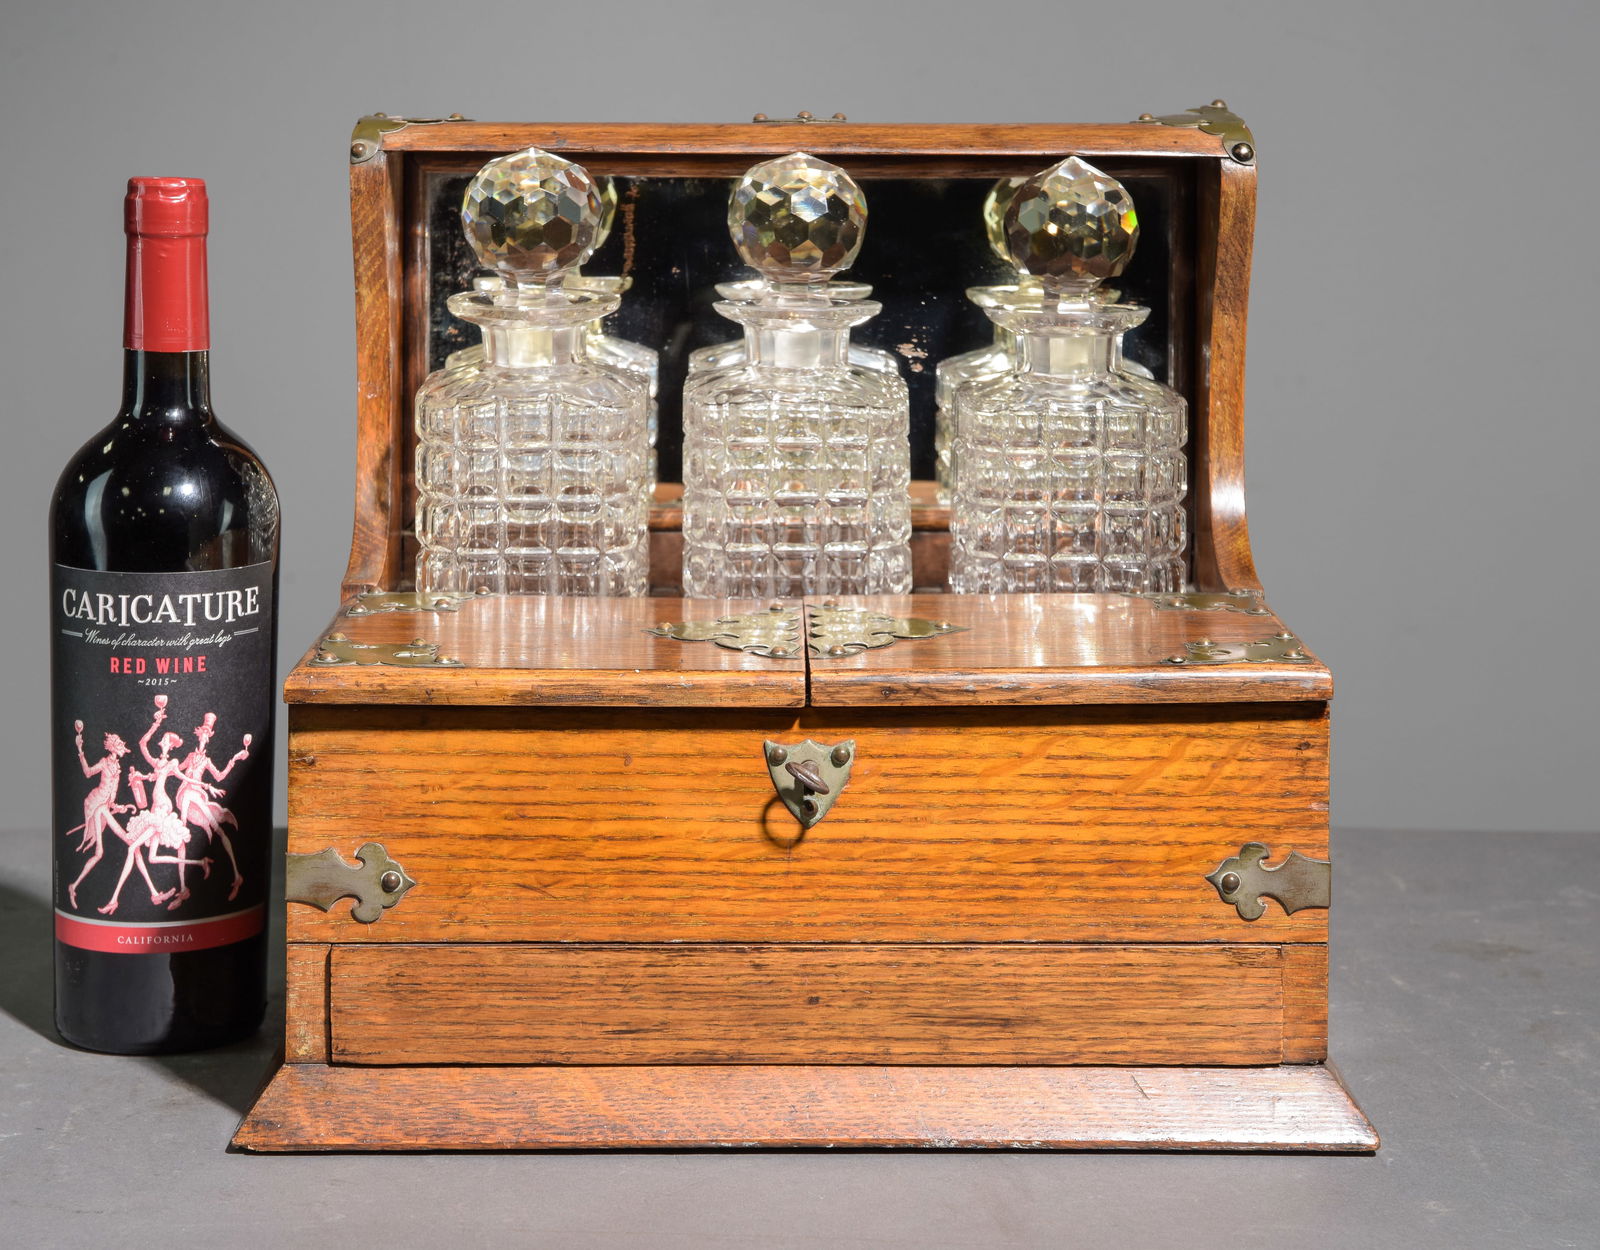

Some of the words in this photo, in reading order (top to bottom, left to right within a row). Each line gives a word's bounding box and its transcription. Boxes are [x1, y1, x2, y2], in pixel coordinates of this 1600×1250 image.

[62, 586, 260, 627] CARICATURE
[84, 627, 110, 645] Wines
[110, 633, 124, 650] of
[121, 633, 165, 648] character
[165, 634, 189, 648] with
[187, 633, 214, 651] great
[213, 629, 232, 648] legs
[110, 656, 147, 675] RED
[155, 655, 207, 674] WINE
[117, 934, 194, 945] CALIFORNIA
